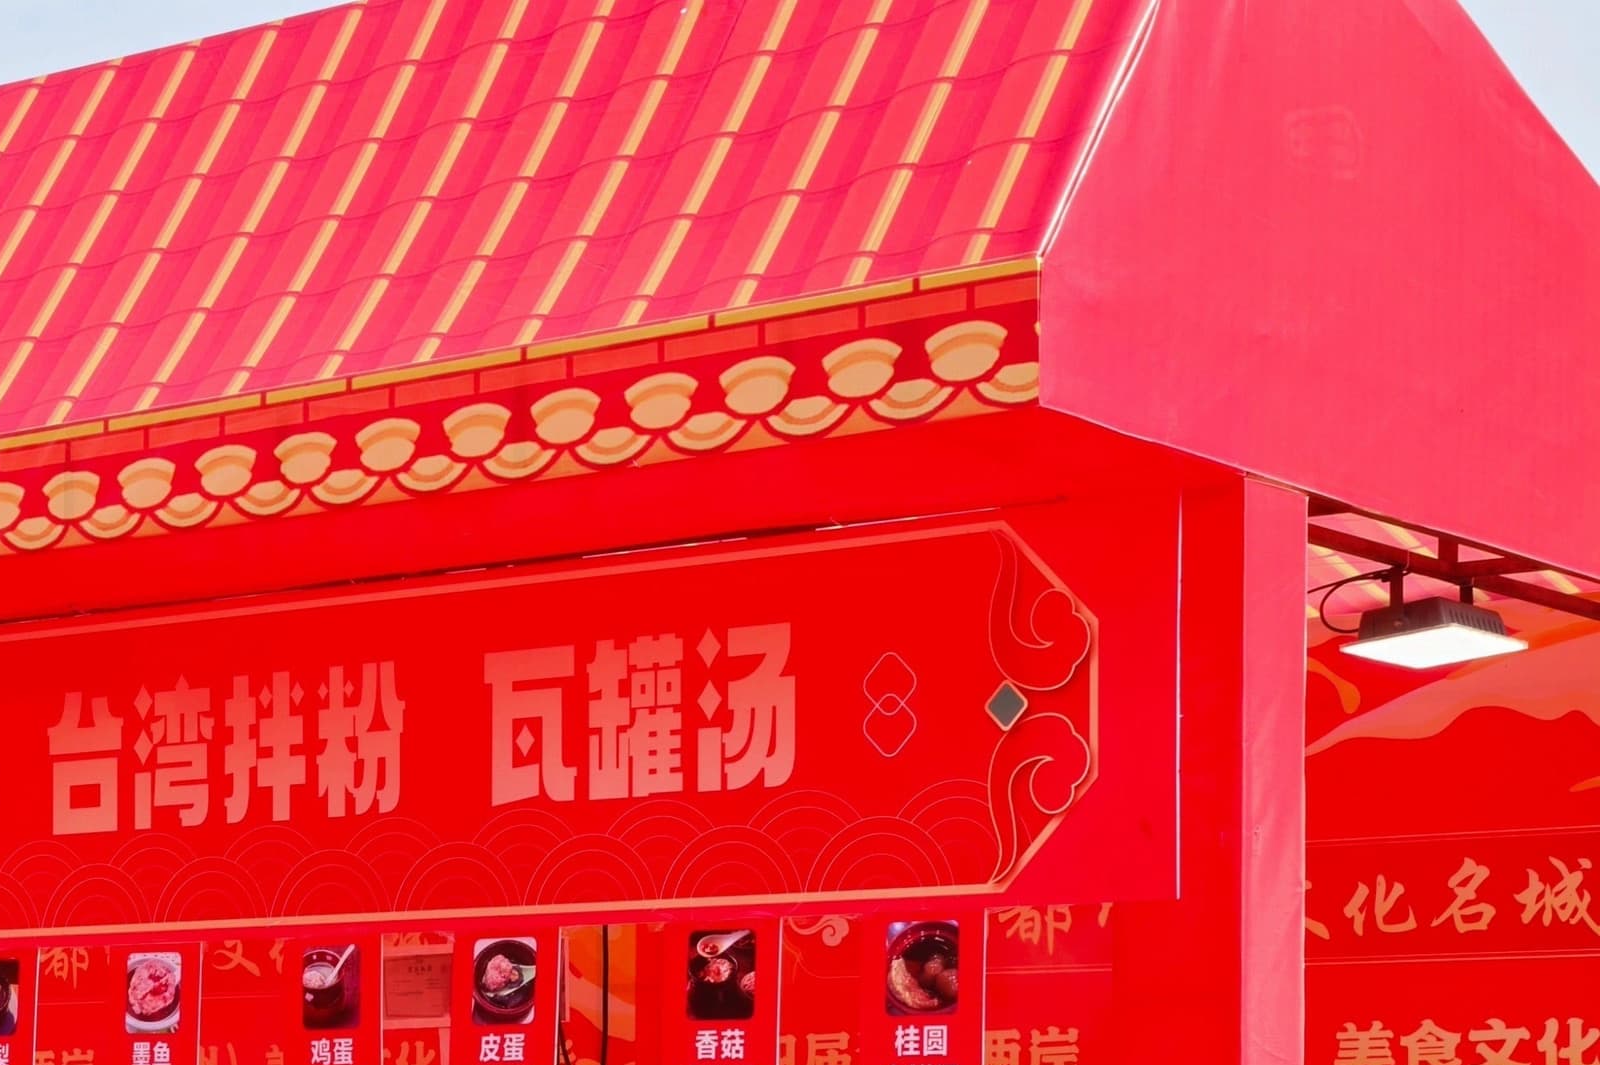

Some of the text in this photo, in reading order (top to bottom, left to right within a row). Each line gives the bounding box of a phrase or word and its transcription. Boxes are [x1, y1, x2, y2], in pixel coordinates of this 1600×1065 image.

[47, 622, 797, 836] 台湾拌粉 瓦罐汤
[311, 1038, 353, 1065] 鸡蛋
[479, 1033, 525, 1062] 皮蛋
[695, 1028, 744, 1060] 香菇
[894, 1025, 948, 1057] 桂圆
